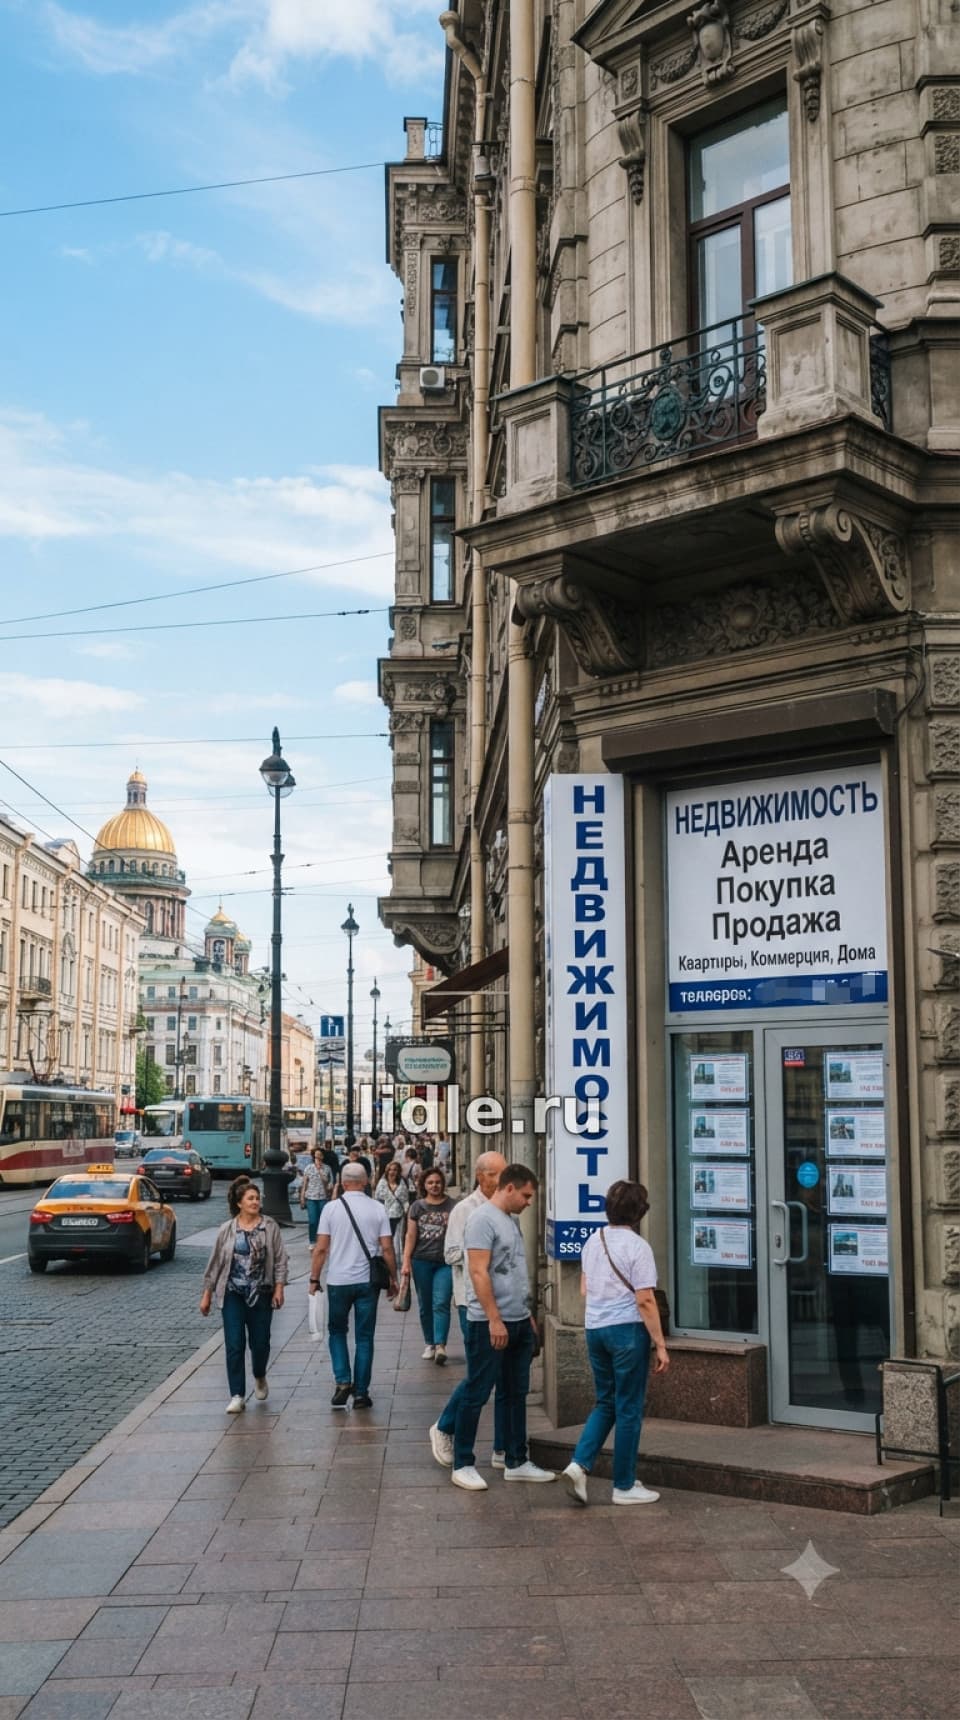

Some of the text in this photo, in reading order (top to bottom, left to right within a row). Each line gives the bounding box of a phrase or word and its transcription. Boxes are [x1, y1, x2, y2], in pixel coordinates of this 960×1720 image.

[675, 781, 878, 837] НЕДВИЖИМОСТЬ
[720, 837, 829, 873] Аренда
[716, 873, 836, 907] Покупка
[712, 910, 841, 945] Продажа
[750, 949, 834, 970] Коммерция,
[837, 944, 876, 964] Дома
[566, 785, 614, 1213] НЕДВИЖИМОСТЬ
